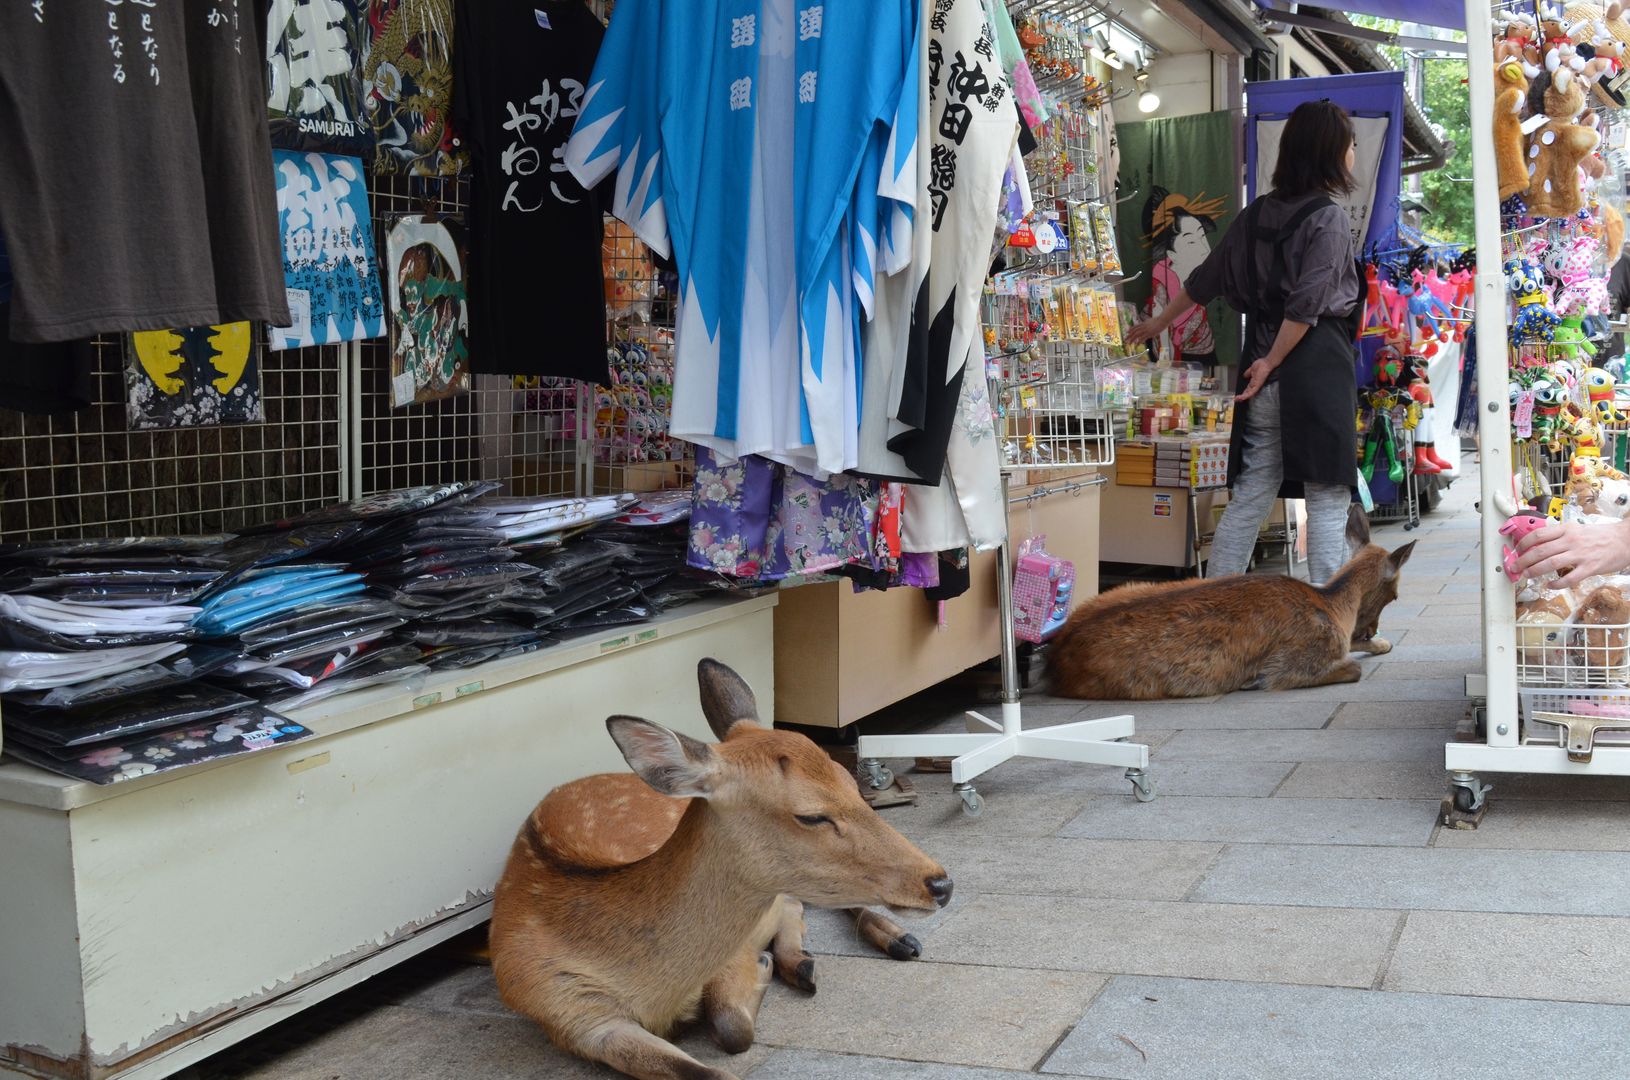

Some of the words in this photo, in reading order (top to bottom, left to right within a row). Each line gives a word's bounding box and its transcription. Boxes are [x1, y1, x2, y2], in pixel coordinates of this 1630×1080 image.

[105, 0, 126, 84] となる
[130, 0, 160, 86] となり
[298, 117, 355, 137] SAMURAI
